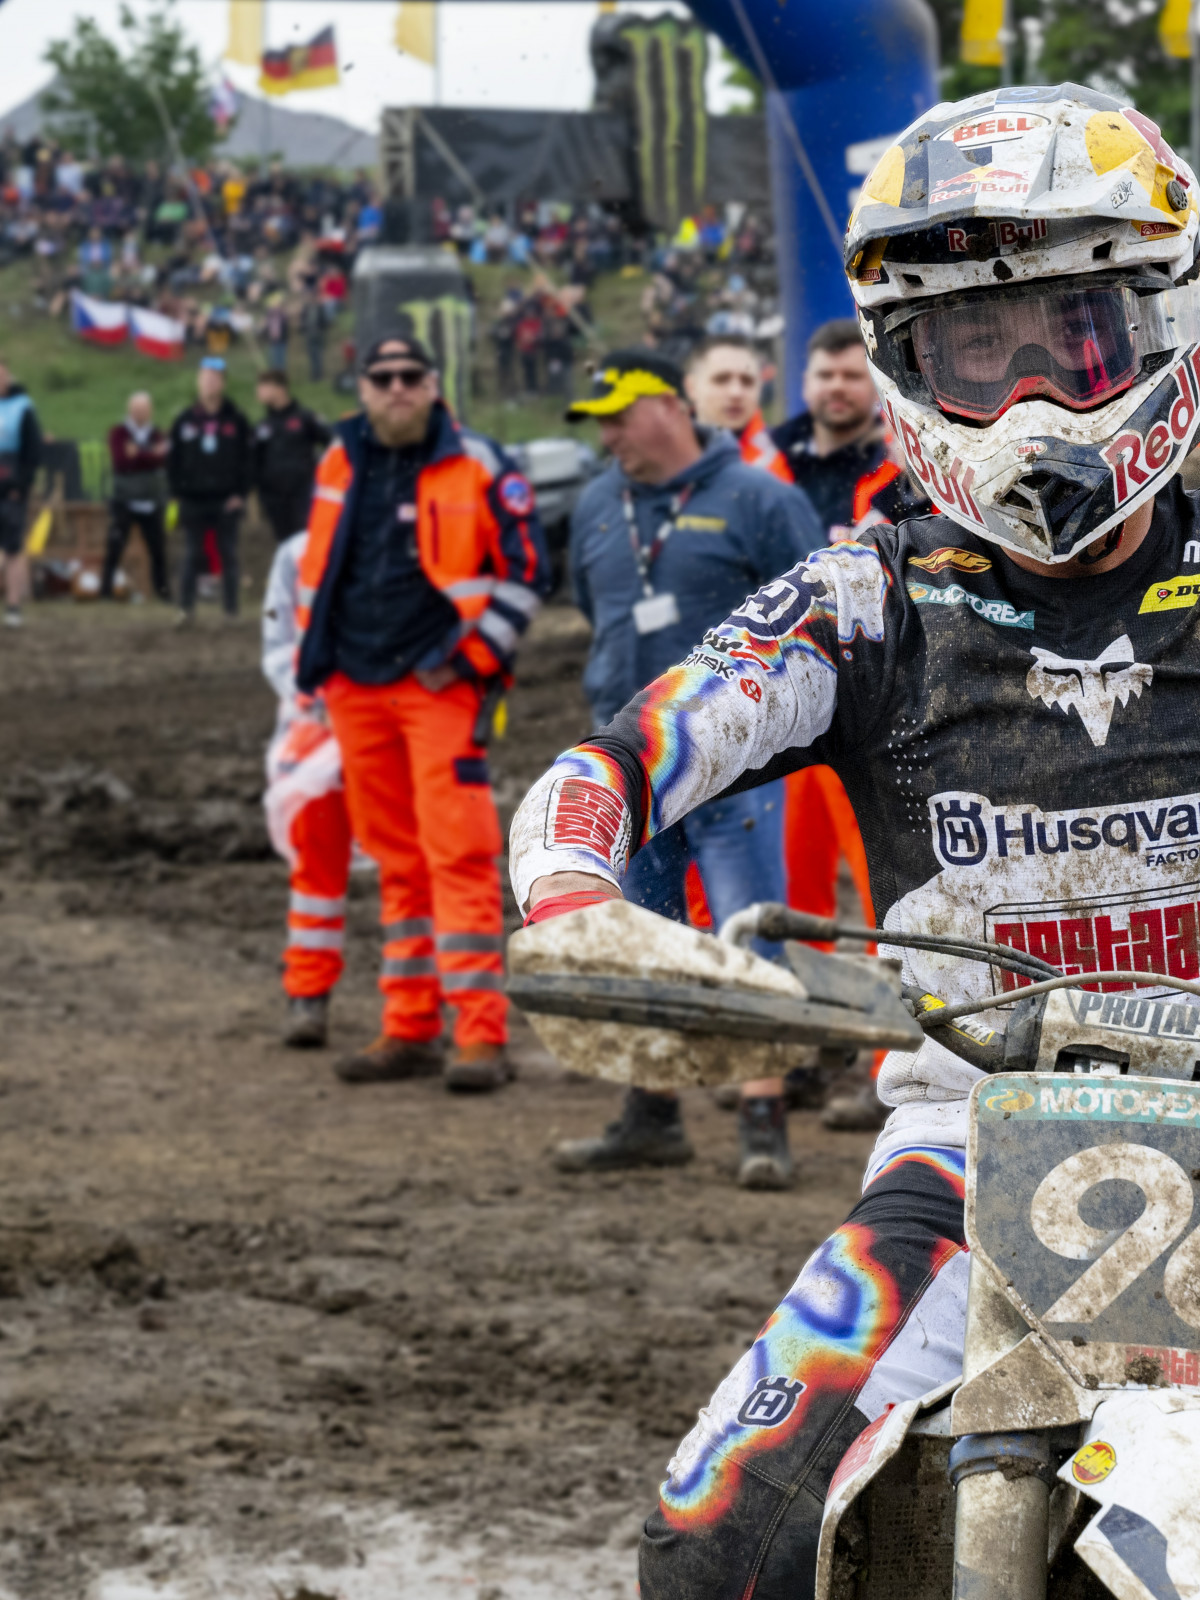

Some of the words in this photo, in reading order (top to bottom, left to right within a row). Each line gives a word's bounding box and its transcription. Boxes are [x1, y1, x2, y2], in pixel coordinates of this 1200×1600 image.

[953, 117, 1035, 143] BELL
[930, 182, 977, 204] Red
[980, 183, 1029, 194] Bull
[947, 223, 999, 252] Rd
[999, 218, 1047, 246] Bull
[1104, 363, 1196, 505] Red
[1017, 444, 1042, 456] BELL
[898, 414, 986, 526] Bull
